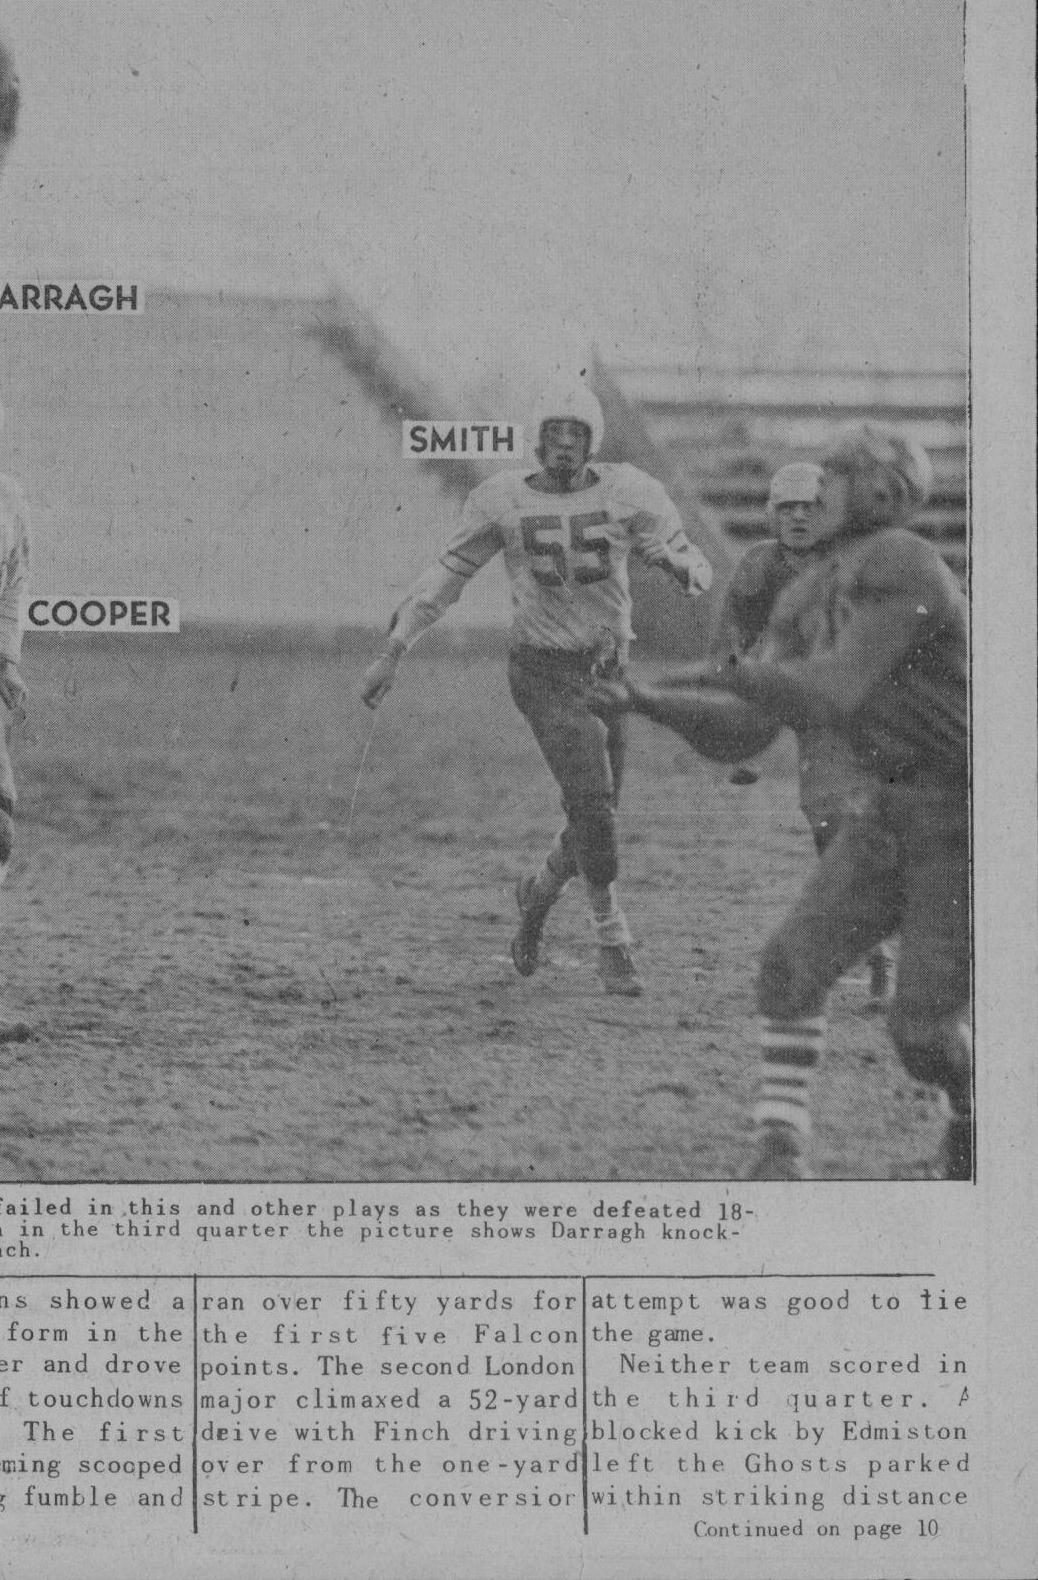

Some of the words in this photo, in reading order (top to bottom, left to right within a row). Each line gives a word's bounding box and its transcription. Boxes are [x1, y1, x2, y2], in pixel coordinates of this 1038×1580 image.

[409, 425, 514, 453] SMITH
[520, 511, 611, 586] 55
[28, 600, 170, 626] COOPER
[89, 1198, 112, 1215] in
[127, 1196, 181, 1217] this
[197, 1198, 234, 1216] and
[251, 1198, 317, 1216] other
[333, 1198, 399, 1224] plays
[416, 1205, 440, 1217] as
[457, 1199, 508, 1222] they
[524, 1205, 577, 1217] were
[593, 1200, 700, 1218] defeated
[720, 1203, 753, 1221] 18-
[21, 1219, 44, 1237] in
[61, 1219, 97, 1237] the
[115, 1219, 180, 1237] third
[197, 1224, 289, 1242] quarter
[307, 1220, 343, 1237] the
[361, 1224, 453, 1242] picture
[471, 1221, 535, 1238] shows
[552, 1221, 644, 1243] Darragh
[663, 1223, 739, 1240] knock-
[592, 1322, 633, 1342] the
[648, 1329, 713, 1347] game.
[44, 1353, 88, 1373] and
[105, 1353, 180, 1374] drove
[201, 1356, 298, 1381] points.
[317, 1355, 363, 1376] The
[381, 1355, 469, 1376] second
[486, 1355, 574, 1376] London
[694, 1519, 803, 1537] Continued
[817, 1525, 840, 1536] on
[854, 1524, 902, 1540] page
[919, 1519, 939, 1537] 10
